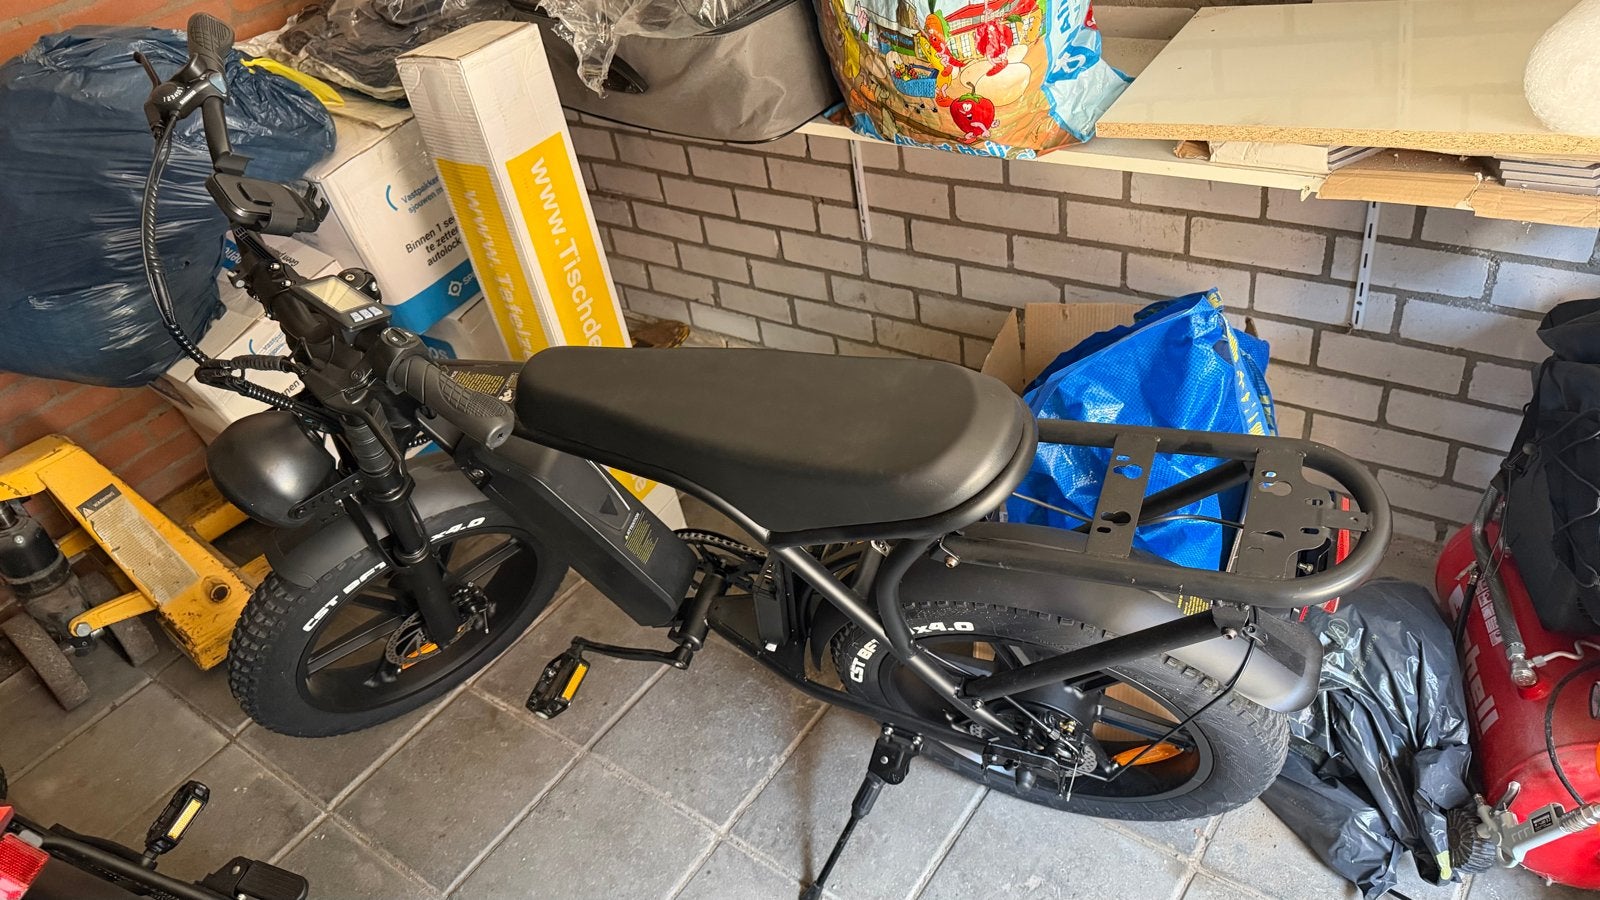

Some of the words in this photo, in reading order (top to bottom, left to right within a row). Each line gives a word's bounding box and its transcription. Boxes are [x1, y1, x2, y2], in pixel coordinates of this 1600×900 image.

[405, 228, 436, 253] Binnen
[443, 216, 455, 226] se
[425, 242, 435, 253] te
[427, 236, 462, 266] autolock
[626, 512, 640, 536] ATTENTION
[302, 595, 339, 632] CST
[849, 656, 866, 683] CST
[909, 621, 975, 635] x4.0
